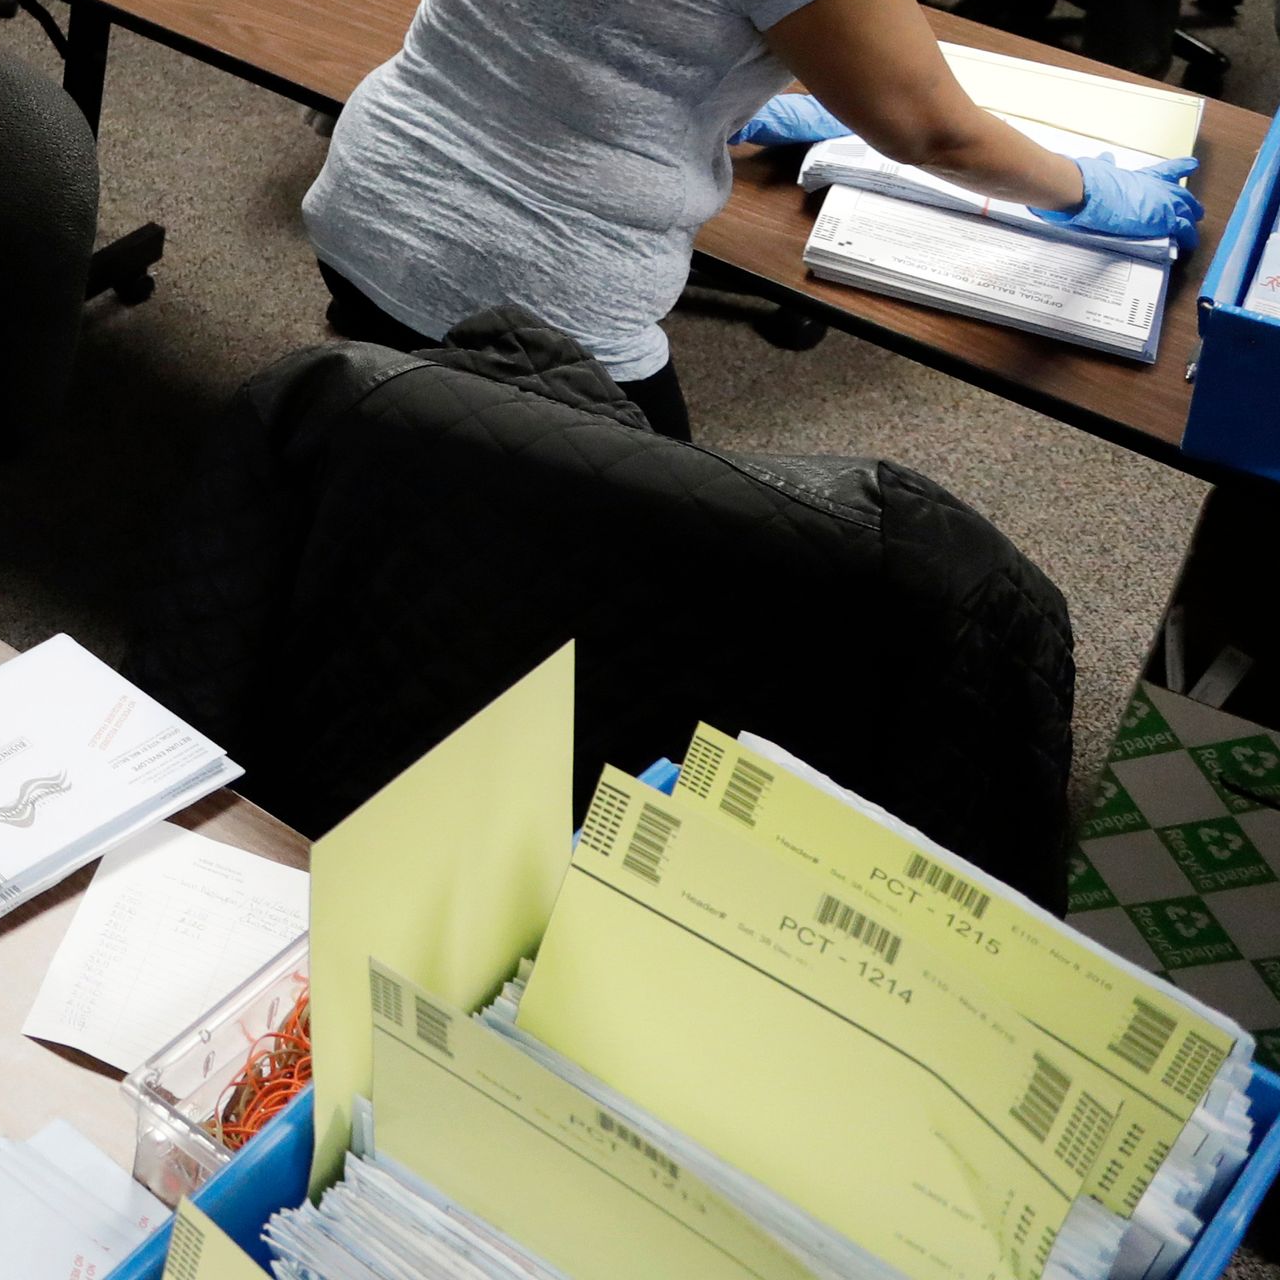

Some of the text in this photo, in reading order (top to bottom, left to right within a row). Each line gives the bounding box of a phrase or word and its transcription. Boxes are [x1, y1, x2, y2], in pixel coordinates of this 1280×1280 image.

[975, 279, 1015, 296] BALLOT
[1017, 290, 1063, 309] OFFICIAL
[164, 734, 192, 754] RETURN
[1123, 730, 1173, 756] paper
[130, 749, 166, 773] ENVELOPE
[1091, 811, 1143, 832] paper
[773, 832, 820, 866] Header#
[1216, 863, 1268, 885] paper
[679, 888, 728, 922] Header#
[867, 866, 923, 907] PCT
[940, 910, 1004, 956] 1215
[775, 912, 835, 958] PCT
[853, 959, 917, 1006] 1214
[1183, 941, 1233, 963] paper
[136, 1214, 151, 1230] NO
[83, 1261, 99, 1278] NO
